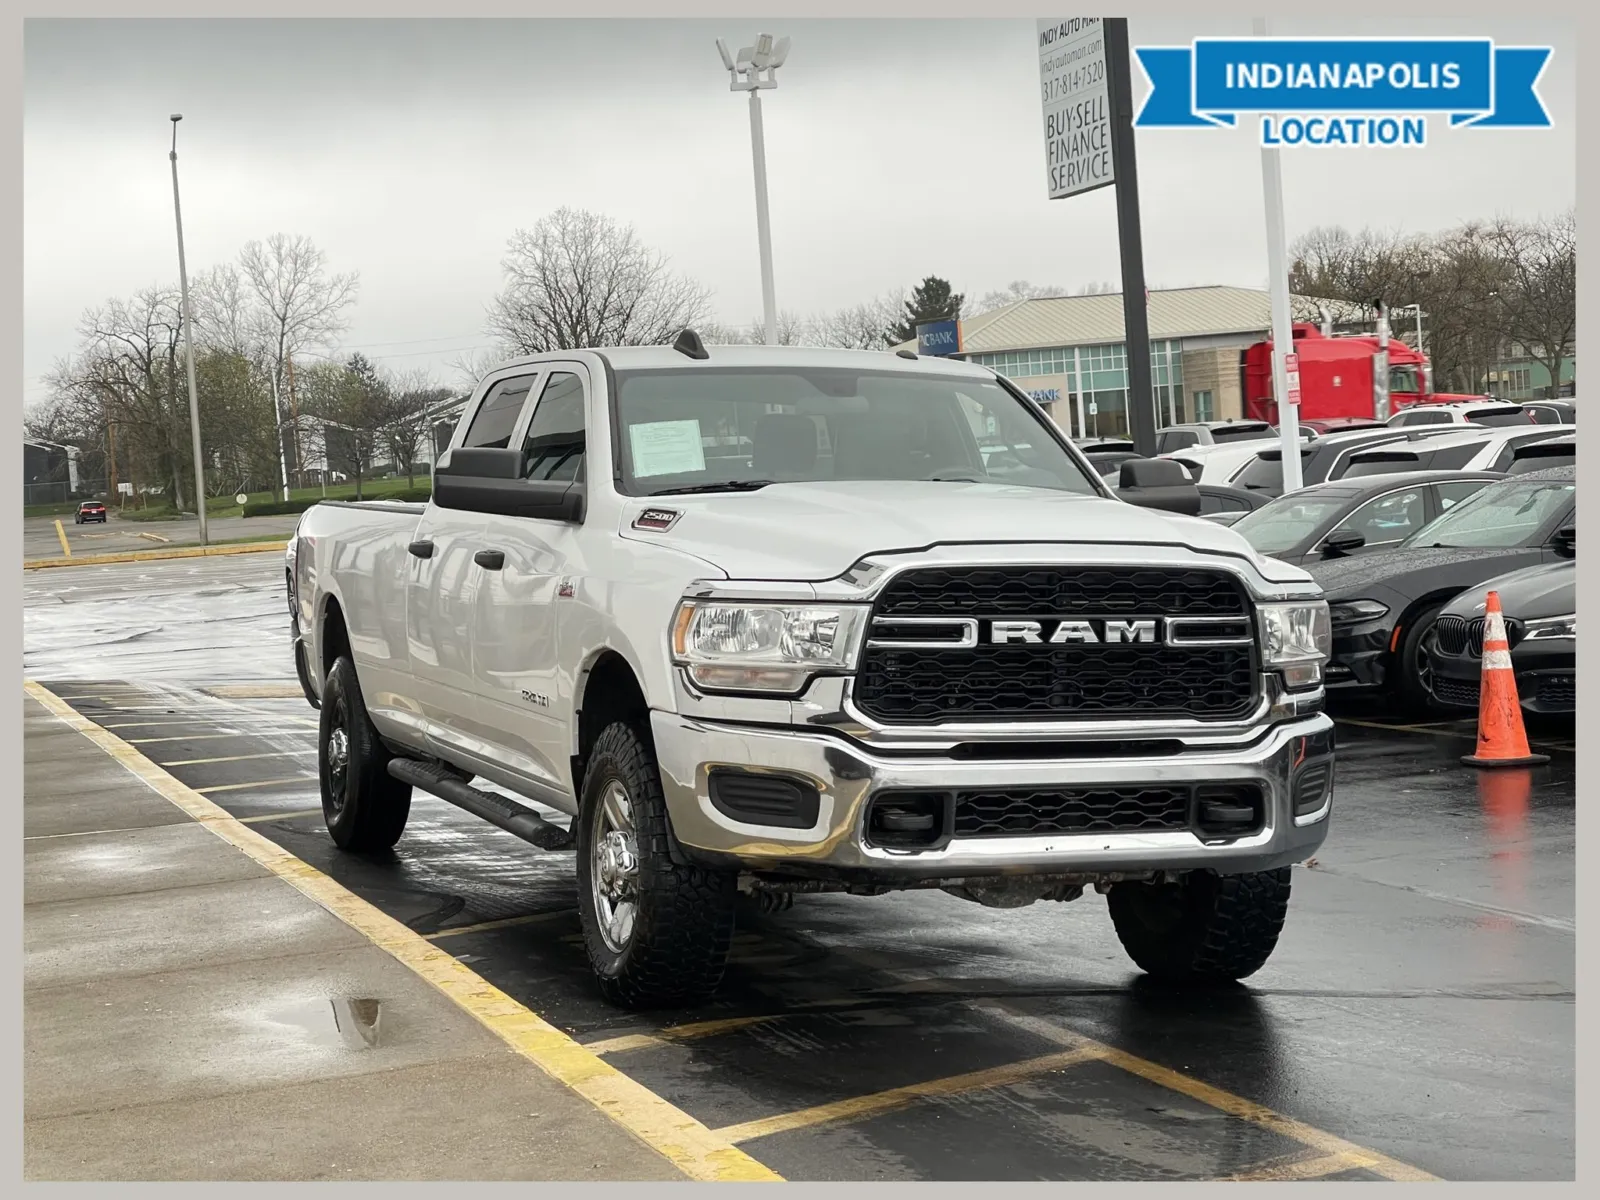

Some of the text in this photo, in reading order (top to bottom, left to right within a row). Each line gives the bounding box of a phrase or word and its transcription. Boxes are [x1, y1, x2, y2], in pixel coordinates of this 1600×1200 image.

[1040, 25, 1058, 47] INDY
[1059, 17, 1080, 39] AUTO
[1041, 39, 1102, 75] indyautoman.com
[1049, 123, 1107, 166] FINANCE
[1051, 151, 1109, 192] SERVICE
[643, 511, 674, 521] 2500
[991, 620, 1157, 644] RAM
